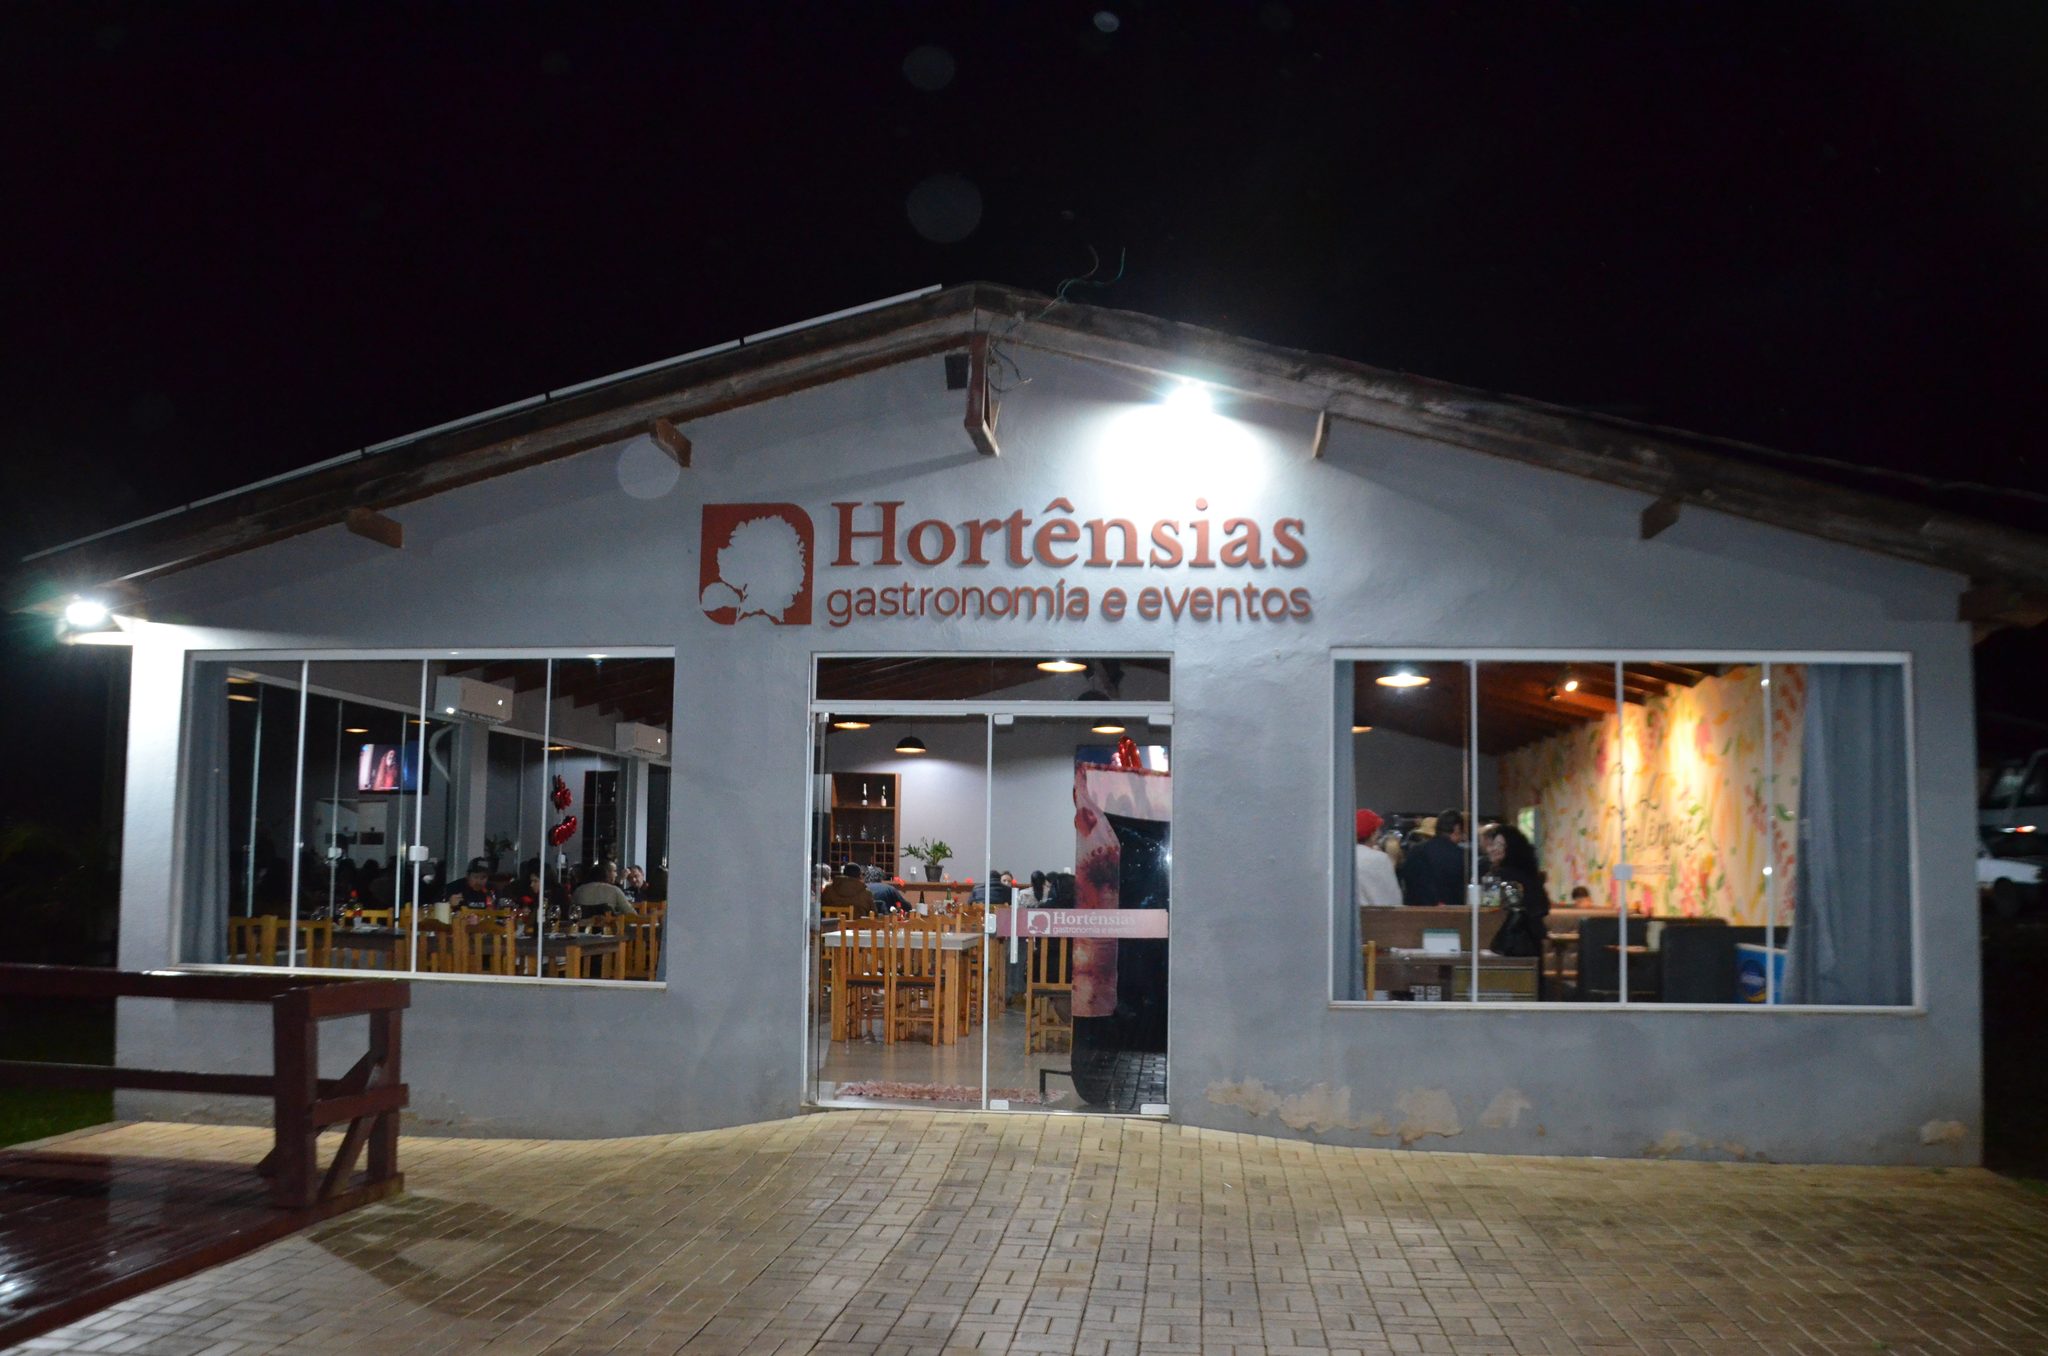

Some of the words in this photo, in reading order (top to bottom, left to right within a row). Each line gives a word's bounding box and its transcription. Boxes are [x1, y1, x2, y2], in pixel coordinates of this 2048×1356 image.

[829, 497, 1306, 568] Hortênsias
[1101, 586, 1128, 622] e
[1137, 582, 1312, 622] eventos
